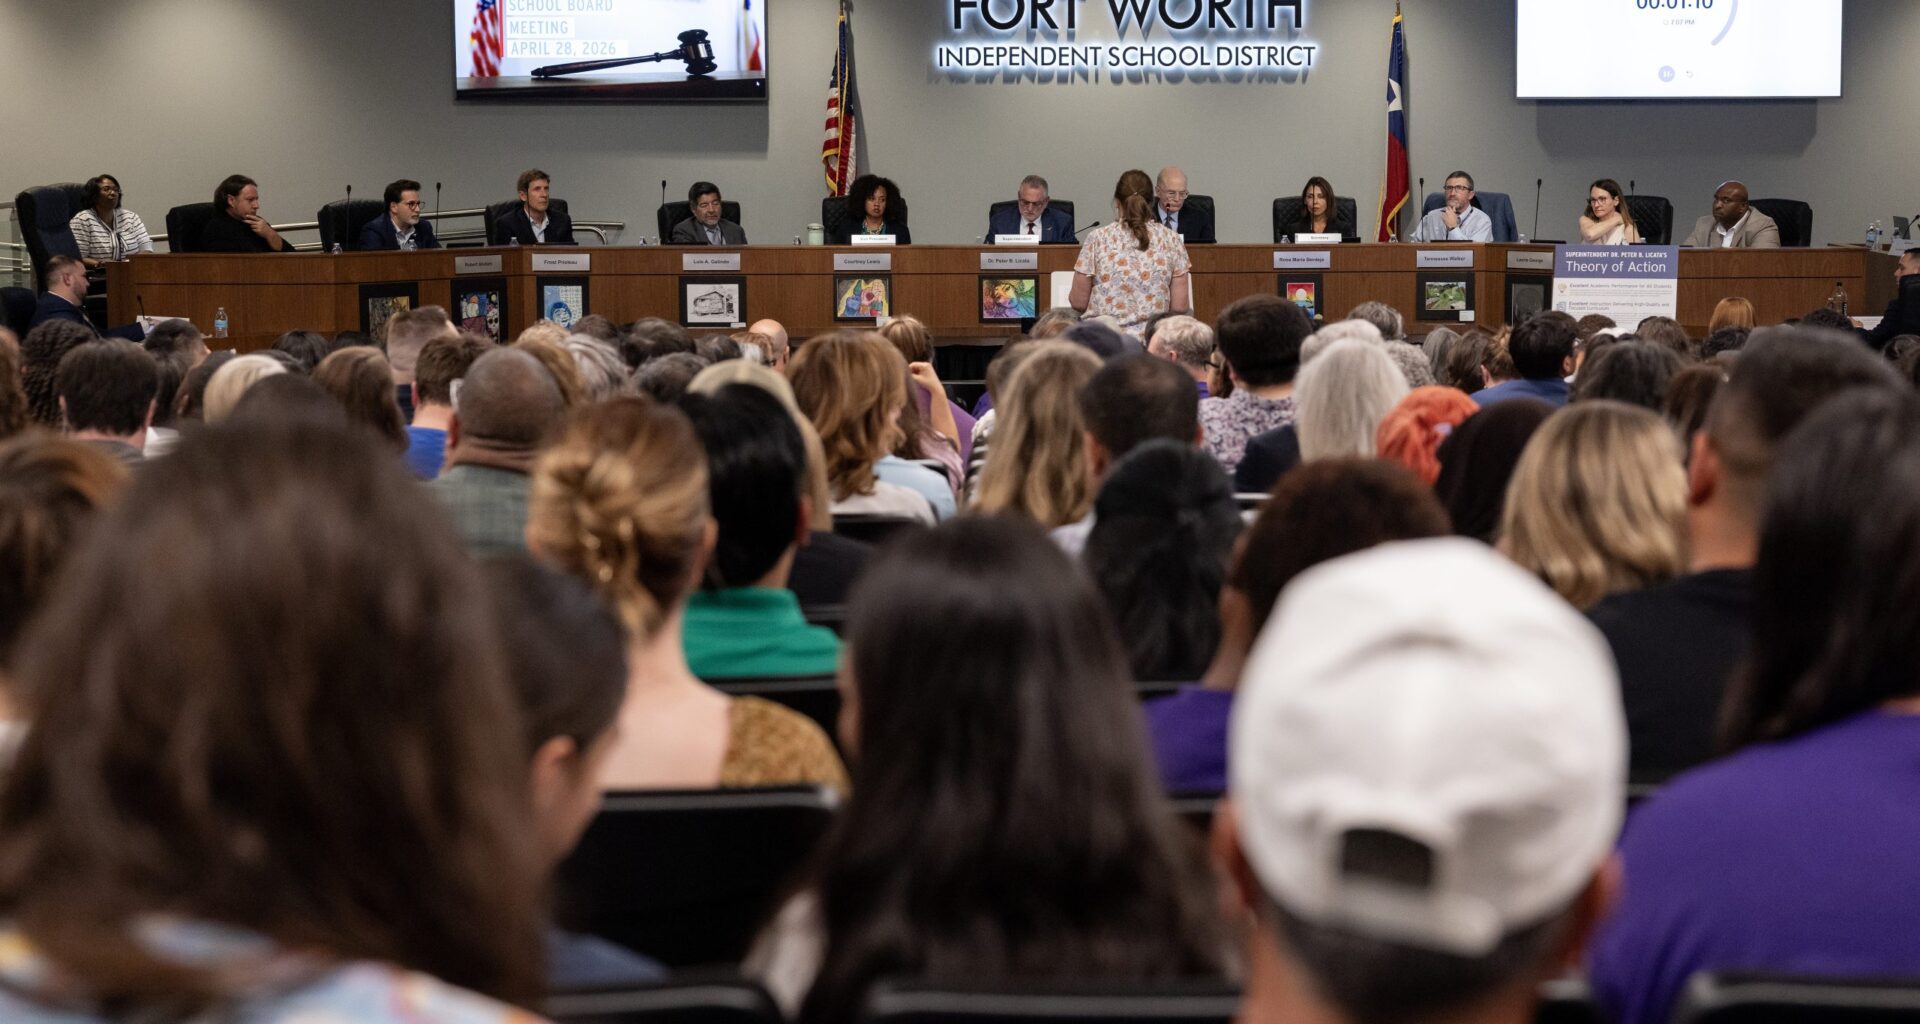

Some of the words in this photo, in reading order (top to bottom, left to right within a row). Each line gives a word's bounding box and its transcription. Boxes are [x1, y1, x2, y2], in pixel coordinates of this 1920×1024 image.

[509, 0, 561, 12] SCHOOL
[568, 0, 613, 12] BOARD
[953, 0, 1077, 30] FORT
[1107, 0, 1303, 30] WORTH
[509, 20, 568, 34] MEETING
[511, 42, 550, 55] APRIL
[555, 42, 577, 57] 28,
[582, 41, 616, 55] 2026
[938, 46, 1102, 67] INDEPENDENT
[1107, 45, 1210, 67] SCHOOL
[1216, 46, 1316, 66] DISTRICT
[1565, 261, 1608, 275] Theory
[1611, 261, 1623, 273] of
[1627, 261, 1666, 273] Action
